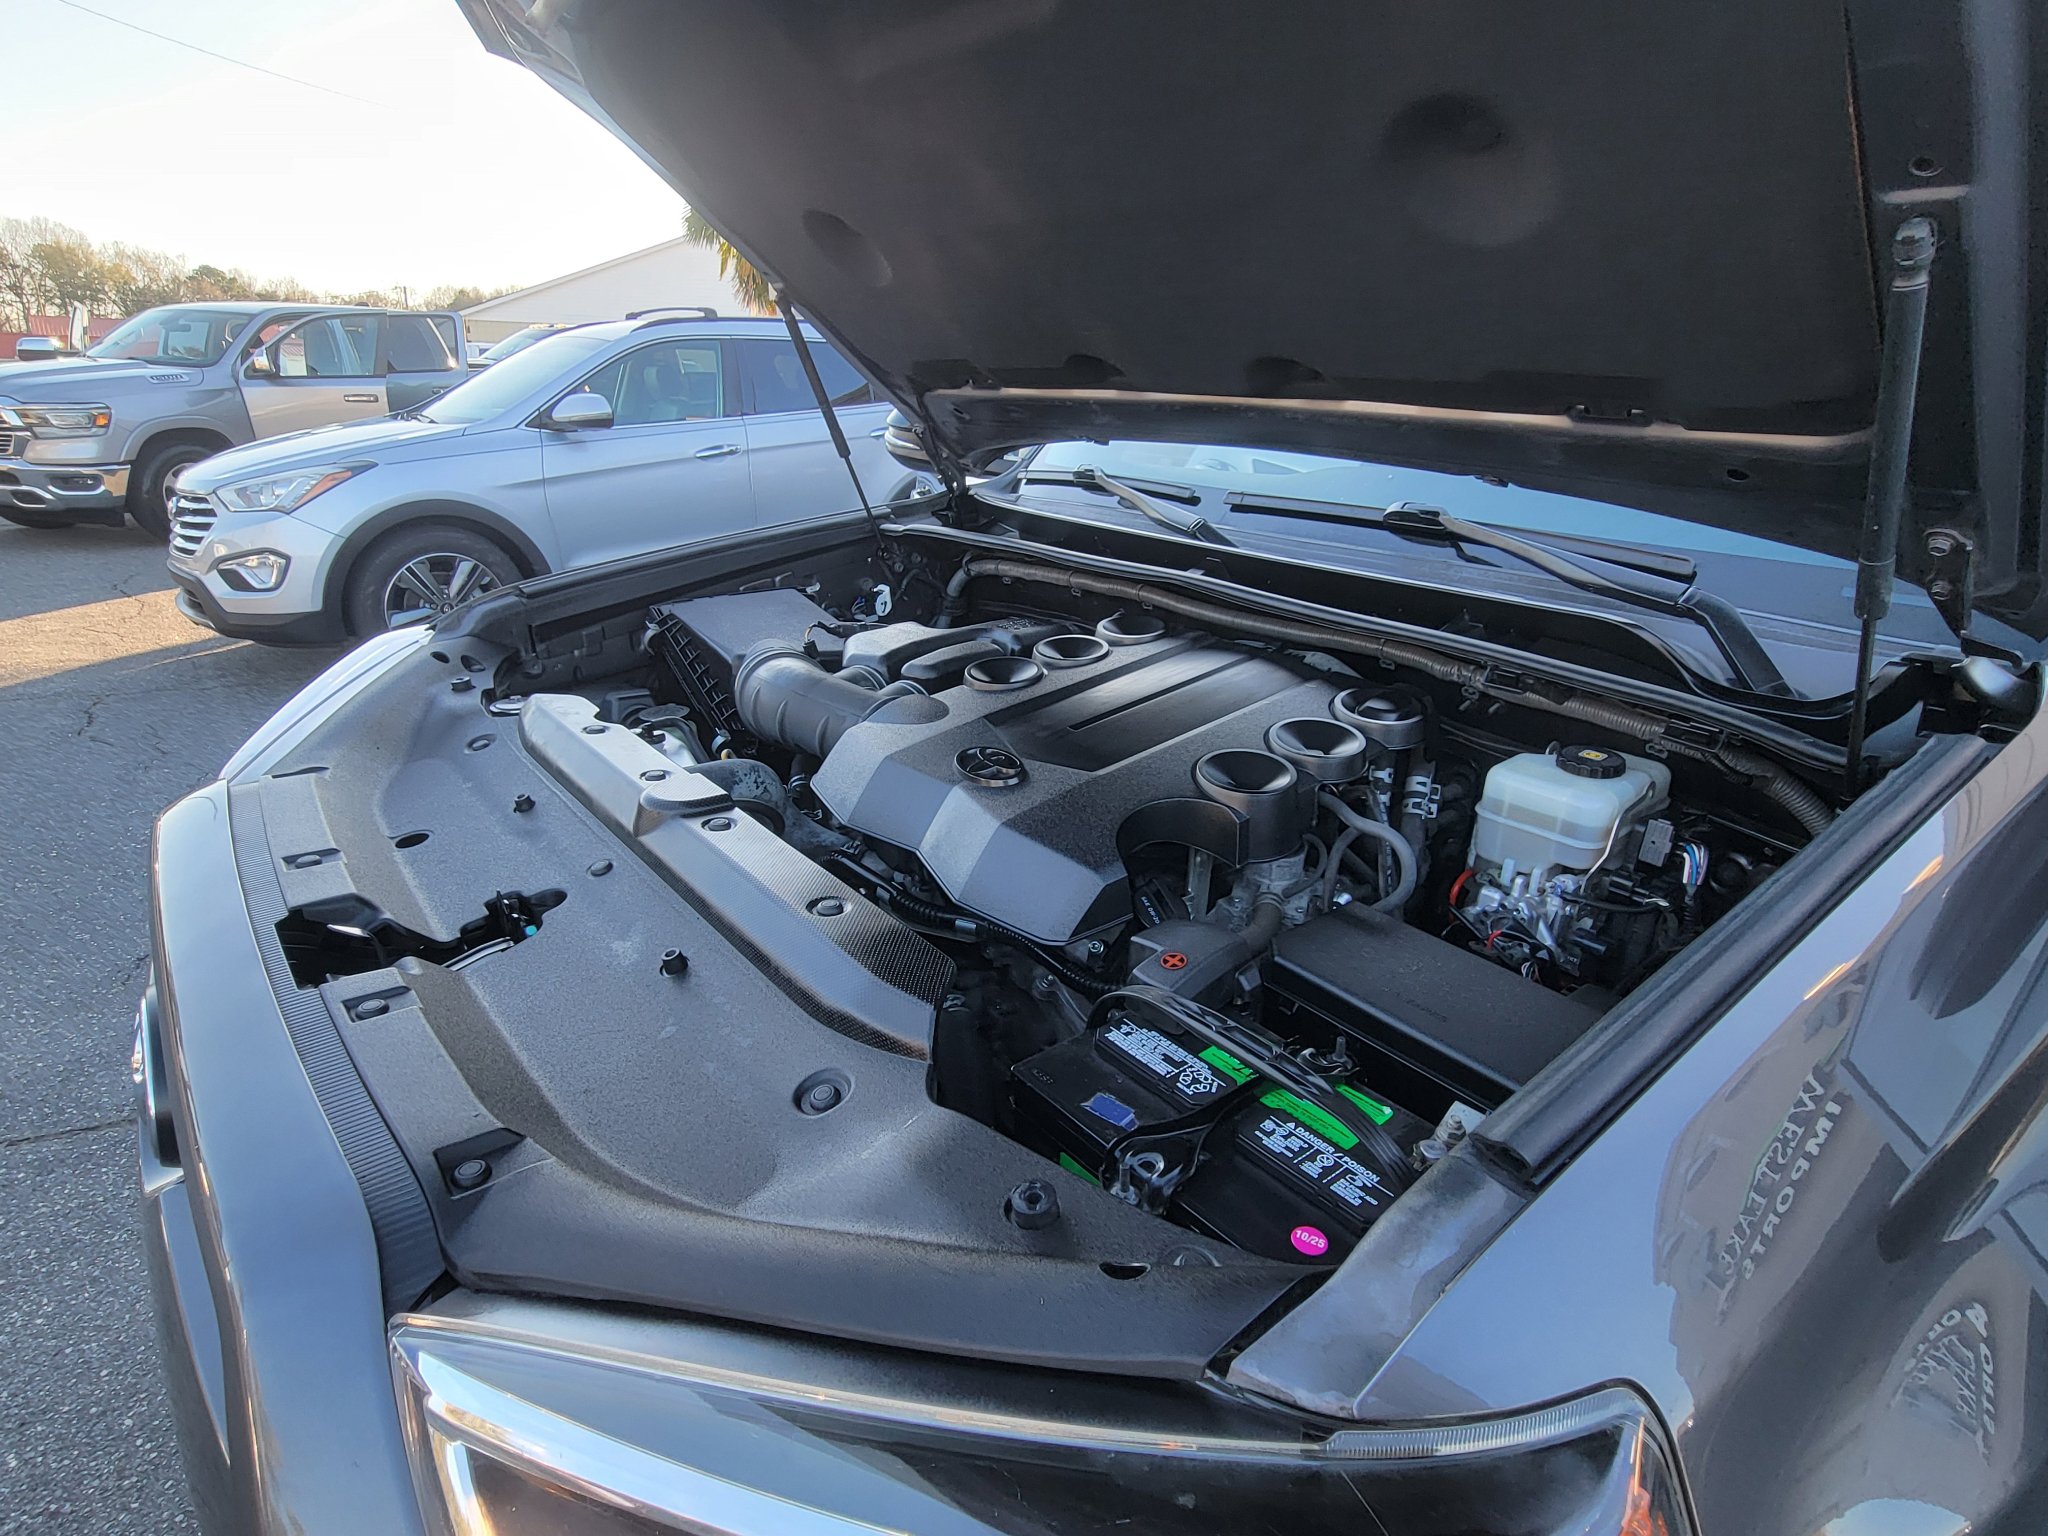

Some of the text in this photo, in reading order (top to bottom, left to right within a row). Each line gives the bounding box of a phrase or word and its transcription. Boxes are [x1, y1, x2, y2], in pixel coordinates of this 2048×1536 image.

[1295, 1127, 1336, 1154] DANGER
[1340, 1157, 1380, 1182] POISON
[1296, 1230, 1326, 1248] 10/25
